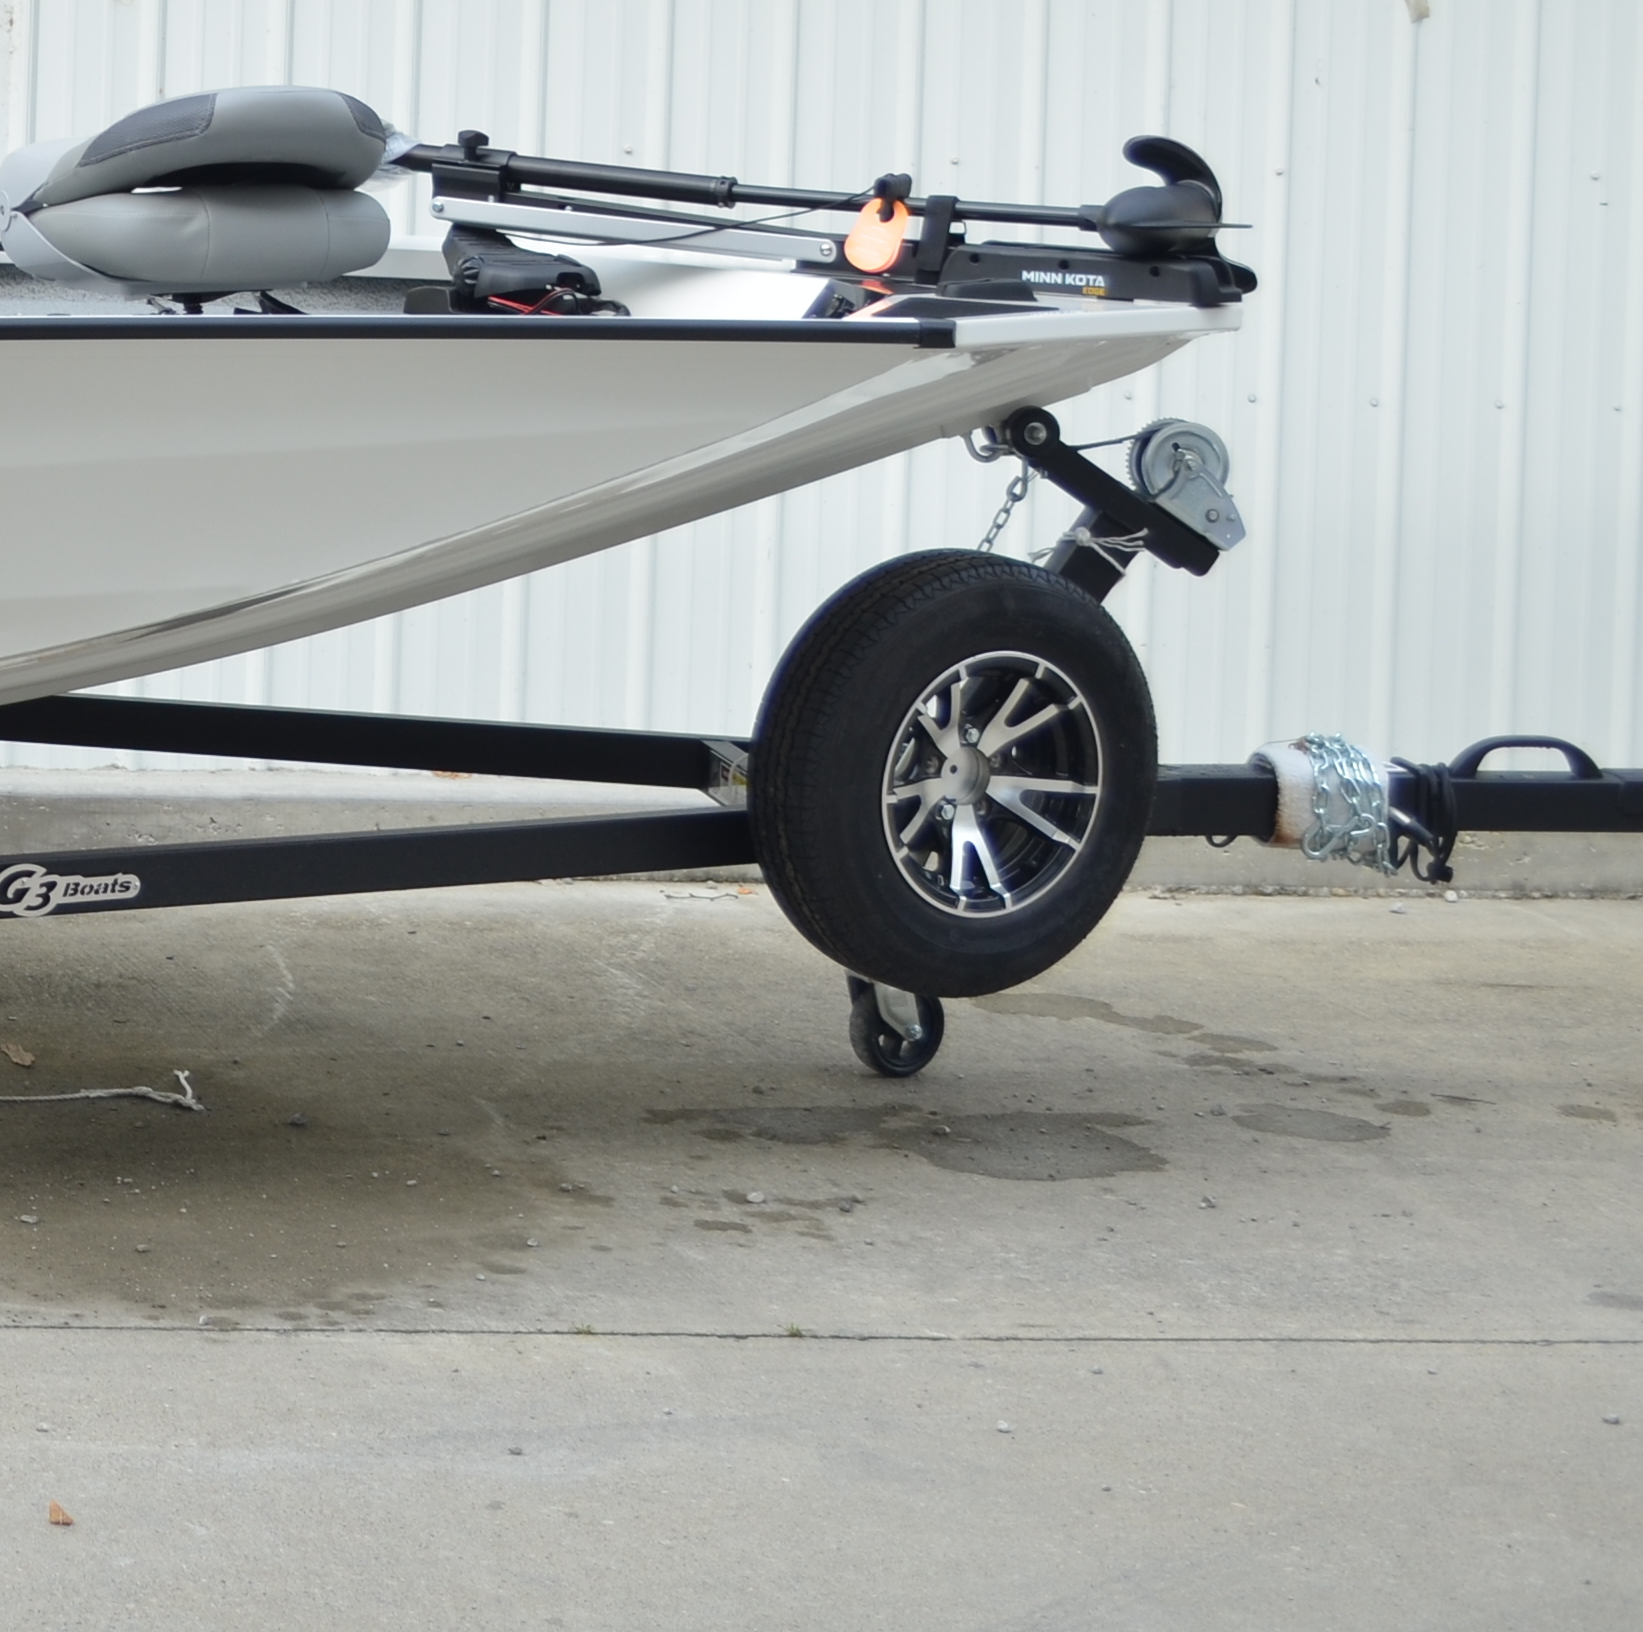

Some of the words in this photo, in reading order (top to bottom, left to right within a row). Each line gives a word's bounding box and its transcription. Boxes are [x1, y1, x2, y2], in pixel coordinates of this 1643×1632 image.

[1022, 270, 1062, 285] MINN
[1065, 274, 1105, 287] KOTA
[62, 878, 132, 898] Boats
